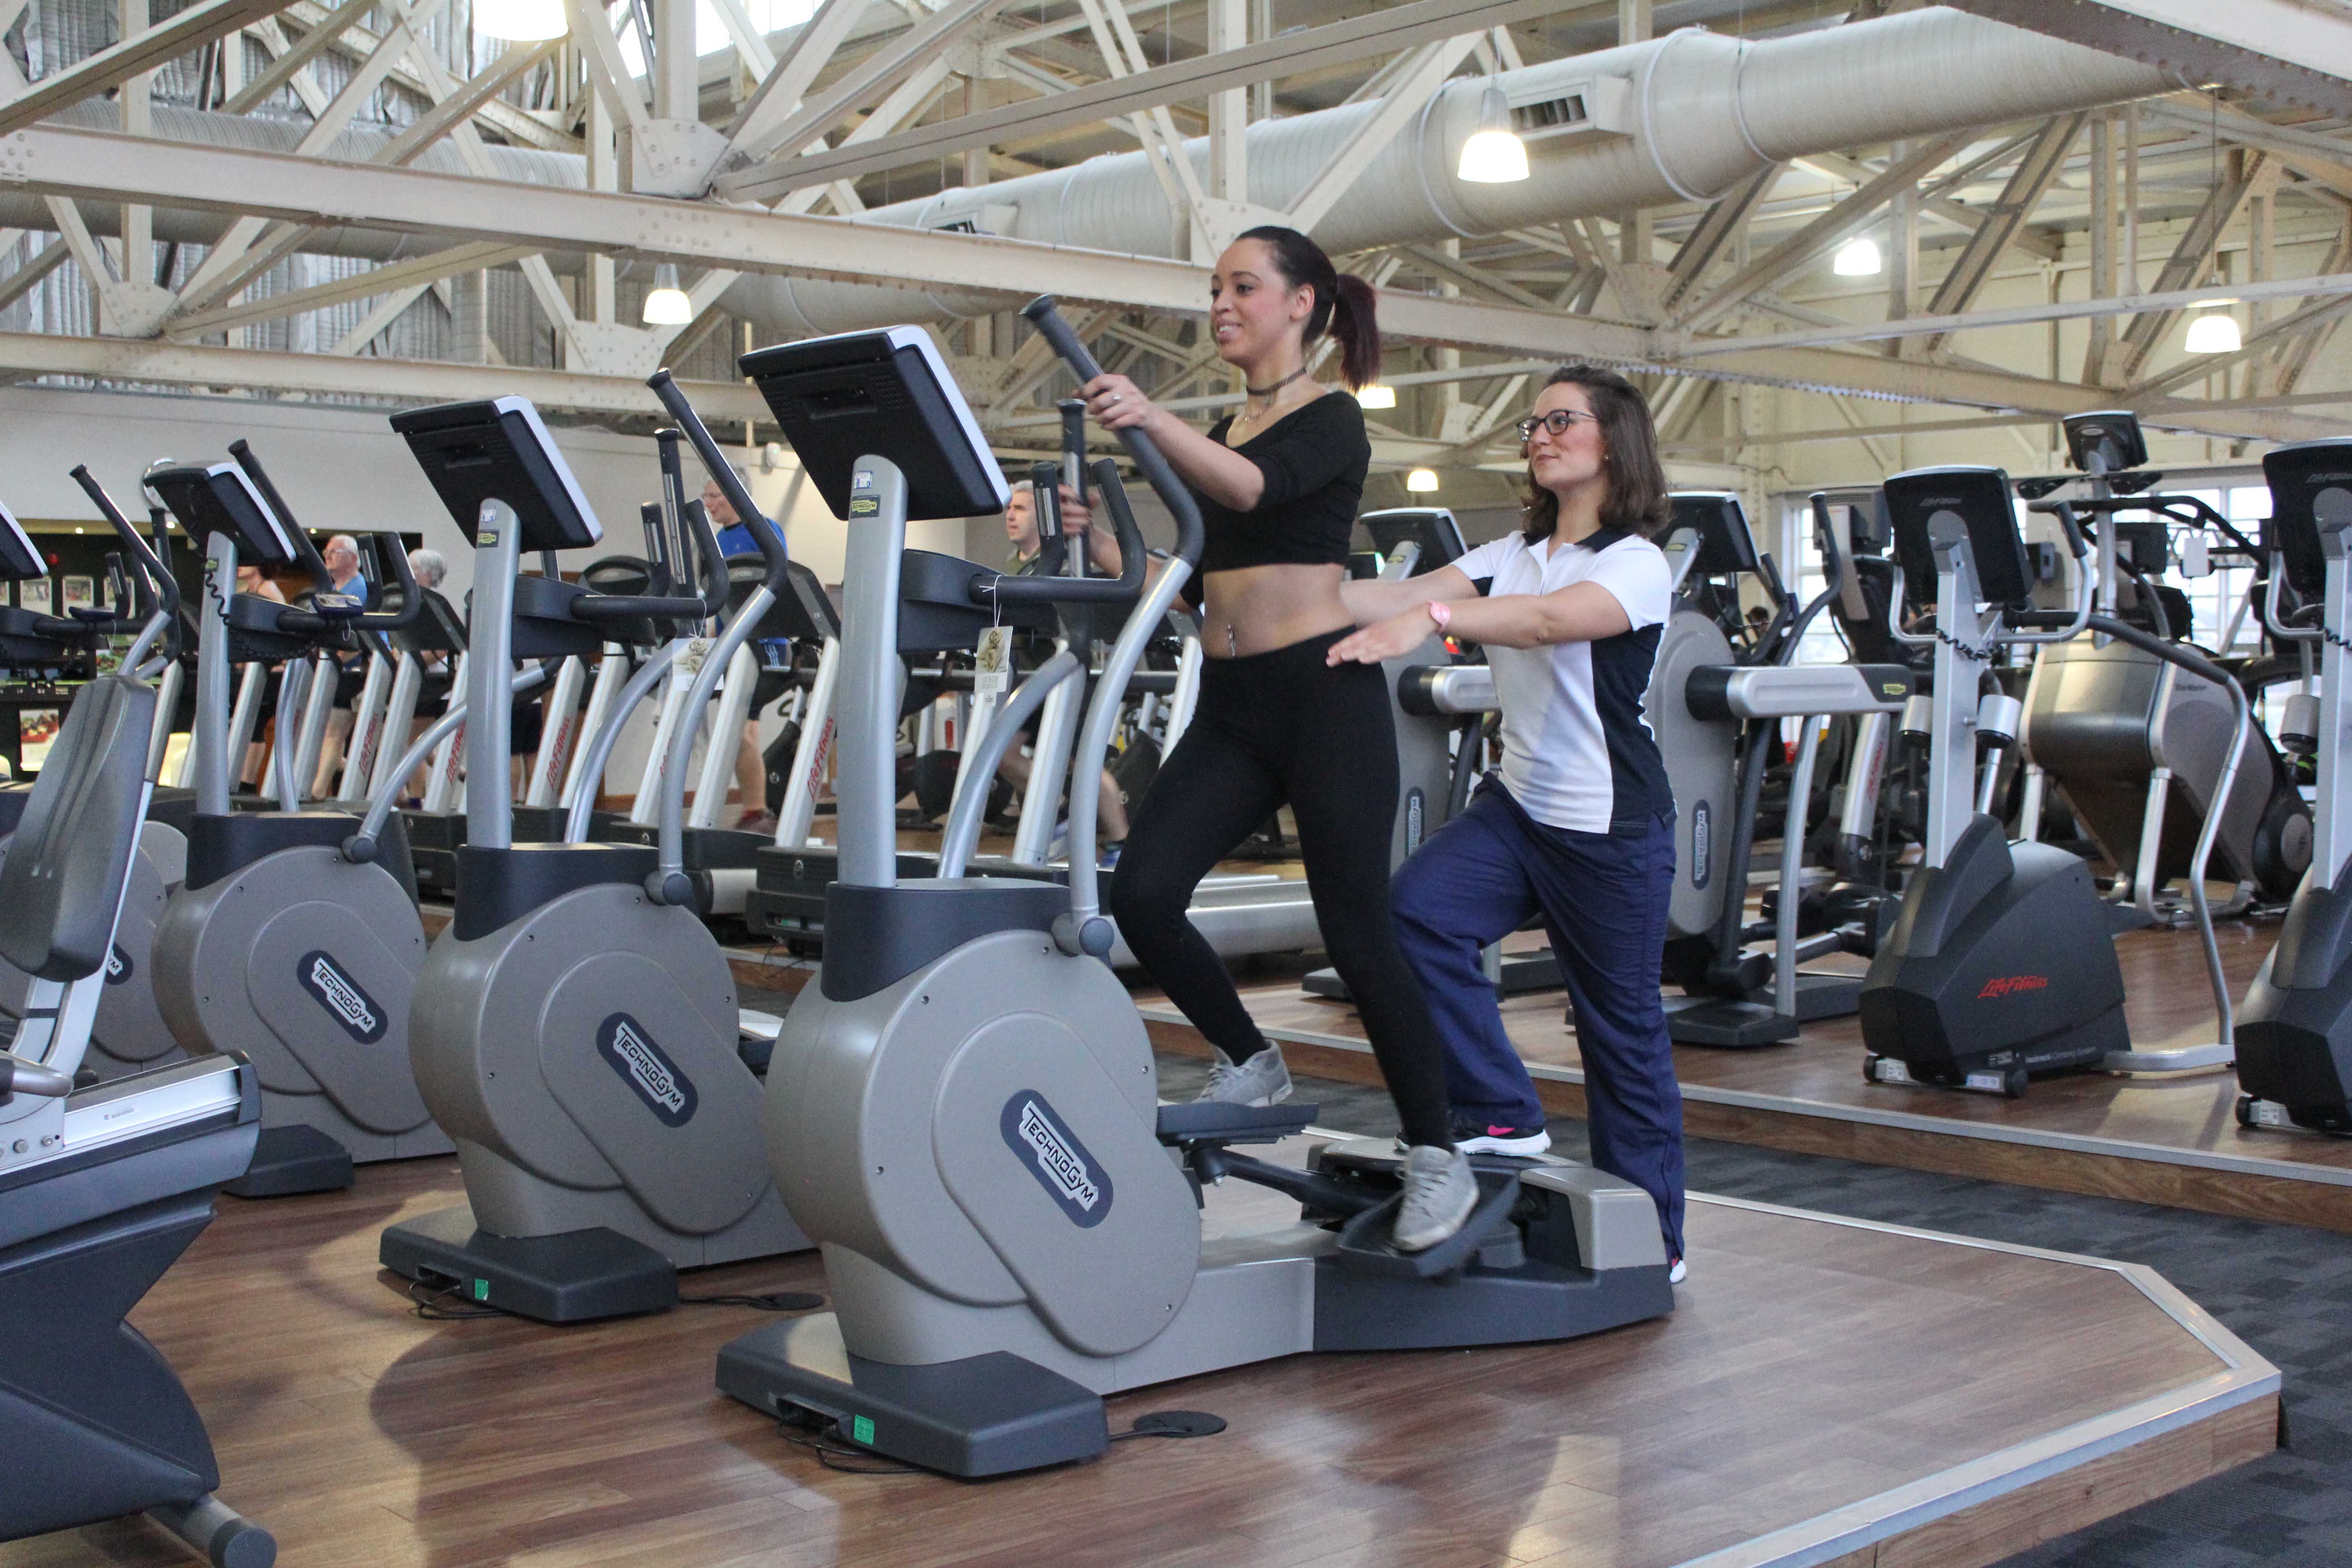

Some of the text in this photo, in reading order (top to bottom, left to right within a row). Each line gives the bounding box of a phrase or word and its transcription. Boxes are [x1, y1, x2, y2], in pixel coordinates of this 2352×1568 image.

[315, 961, 373, 1028] TECHNOGYM
[617, 1027, 681, 1106] TECHNOGYM
[1024, 1107, 1094, 1203] TECHNOGYM
